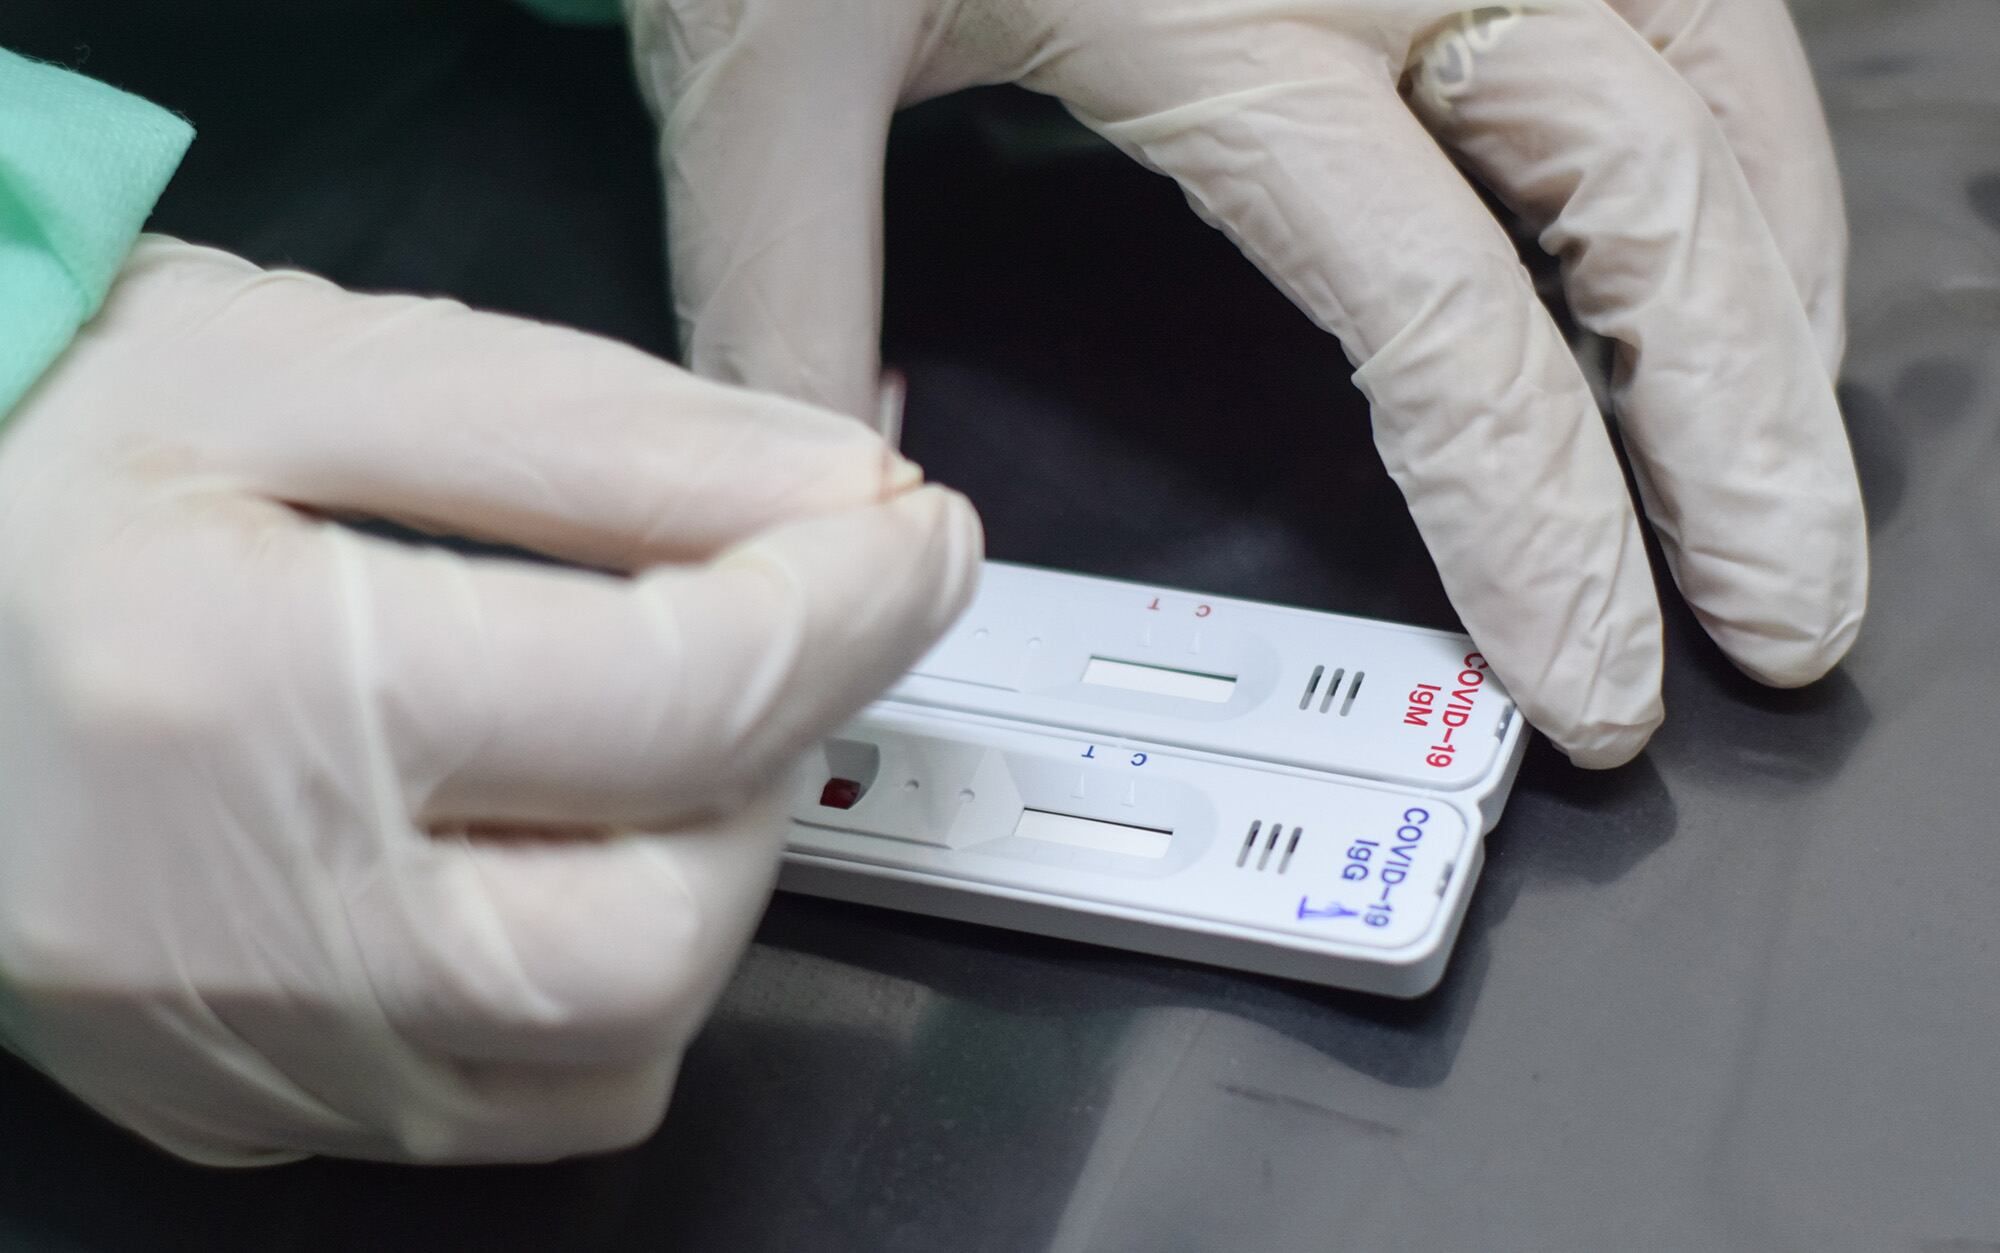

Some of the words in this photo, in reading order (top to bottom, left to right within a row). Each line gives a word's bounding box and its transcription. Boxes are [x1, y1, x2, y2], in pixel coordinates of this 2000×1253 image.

[1147, 598, 1160, 610] T
[1195, 604, 1211, 617] C
[1403, 683, 1441, 727] IgM
[1426, 652, 1488, 768] COVID-19
[1081, 745, 1095, 758] T
[1130, 752, 1147, 766] C
[1341, 839, 1380, 882] IgG
[1363, 807, 1430, 928] COVID-19
